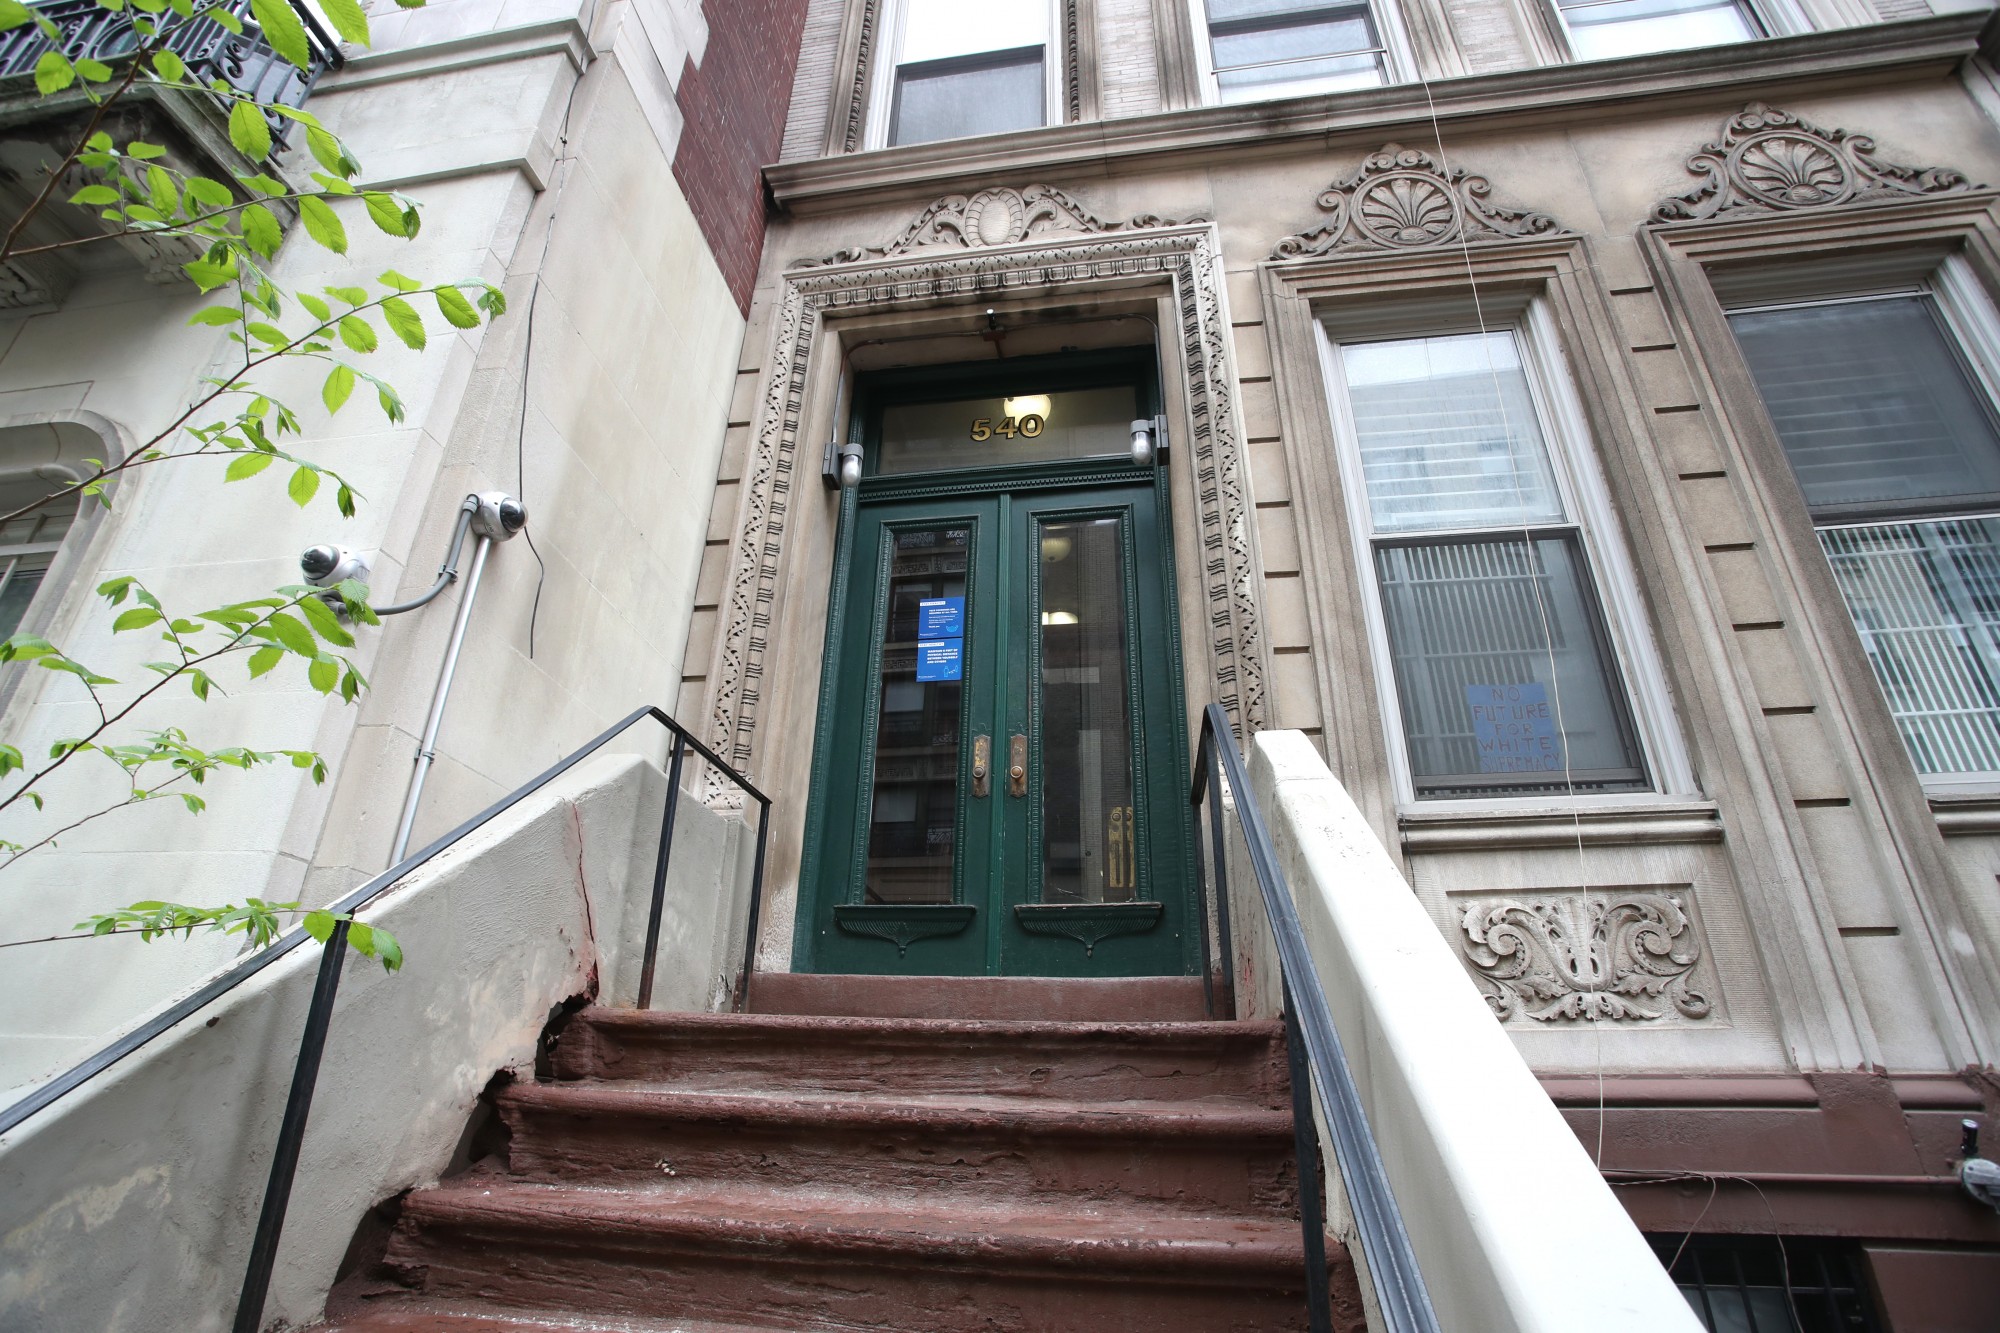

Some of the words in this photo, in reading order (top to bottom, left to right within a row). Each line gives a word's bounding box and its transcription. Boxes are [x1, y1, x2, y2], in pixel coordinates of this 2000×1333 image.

[970, 414, 1044, 442] 540
[1492, 687, 1520, 701] NO
[1473, 703, 1549, 721] FUTURE
[1495, 723, 1532, 735] FOR
[1479, 737, 1551, 752] WHITE
